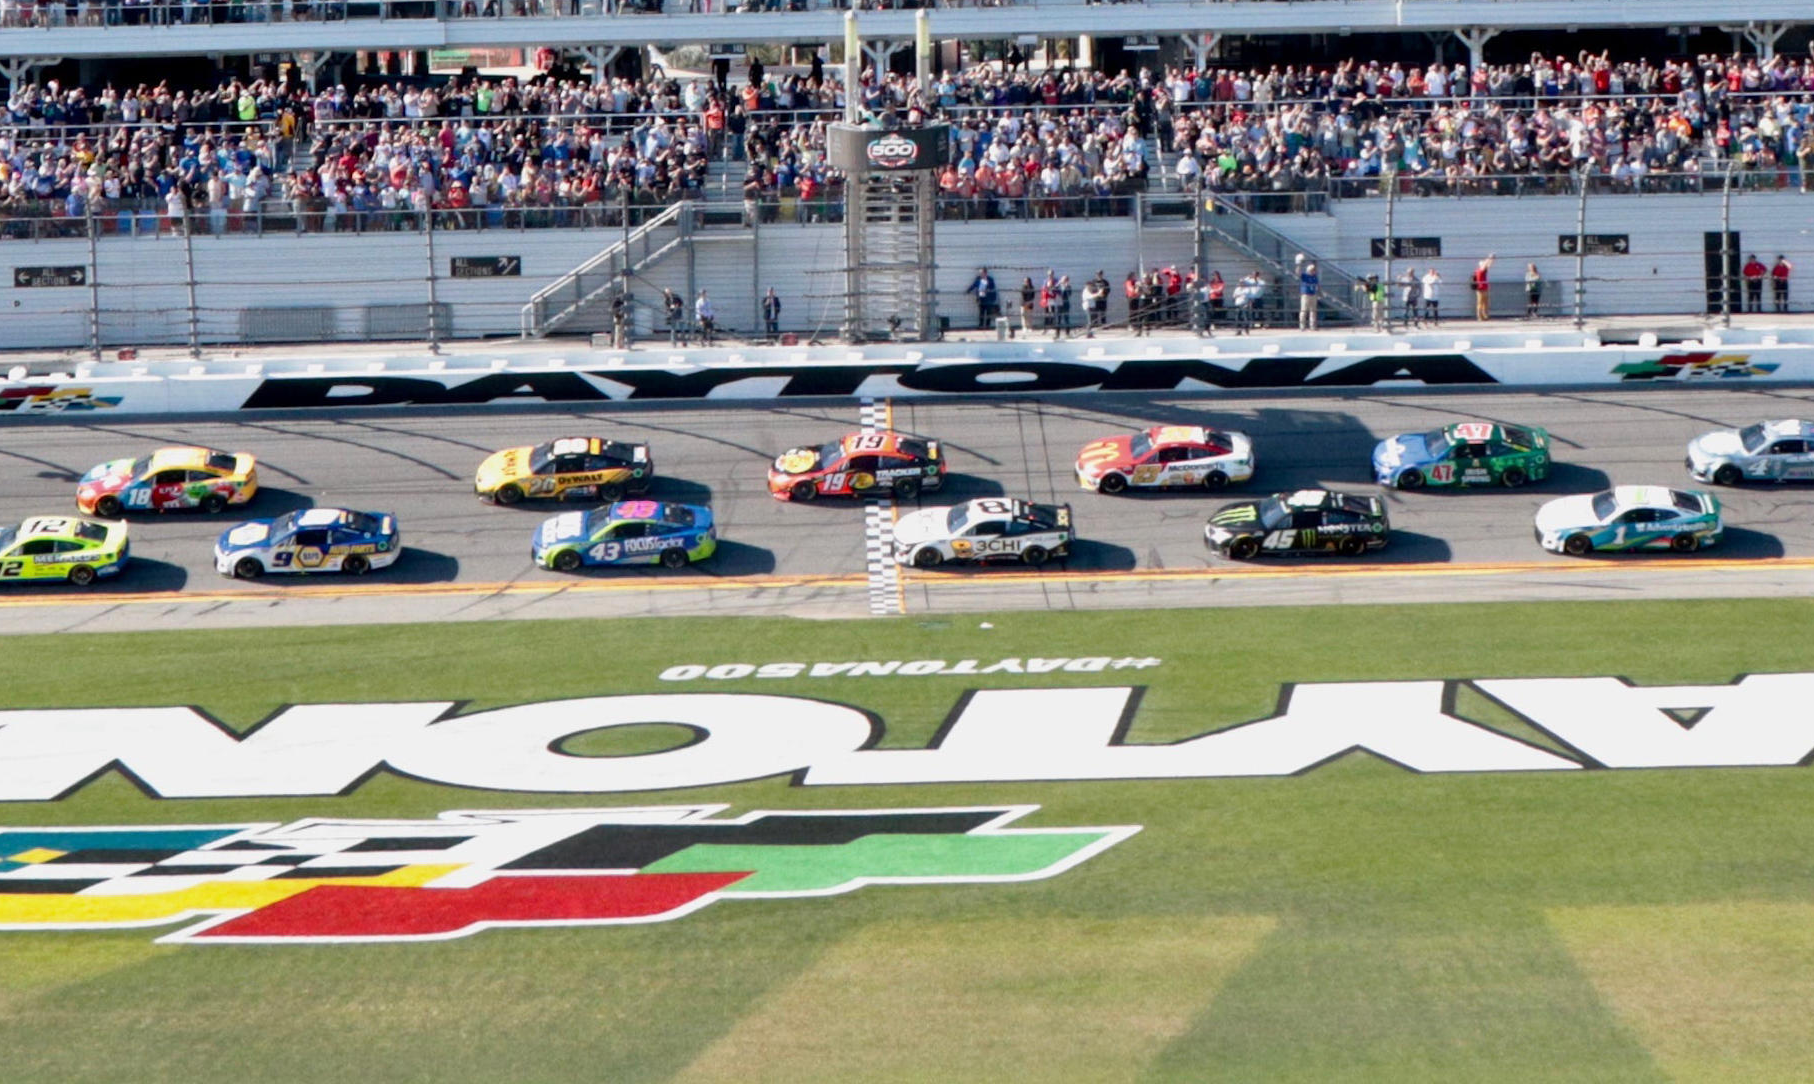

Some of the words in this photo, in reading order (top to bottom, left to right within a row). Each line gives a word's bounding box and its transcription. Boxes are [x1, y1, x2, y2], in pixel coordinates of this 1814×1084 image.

[872, 144, 912, 156] 500
[455, 258, 468, 267] ALL
[42, 268, 55, 277] ALL
[455, 267, 492, 276] SECTIONS
[32, 277, 69, 286] SECTIONS
[241, 355, 1498, 408] DAYTONA
[1455, 424, 1492, 440] 47
[852, 436, 884, 449] 19
[875, 468, 922, 478] TRACKER
[1431, 465, 1453, 482] 47
[1748, 458, 1768, 475] 4
[823, 474, 845, 491] 19
[128, 488, 152, 505] 18
[977, 501, 1011, 513] 8
[30, 520, 67, 533] 12
[1262, 529, 1299, 549] 45
[1613, 526, 1627, 545] 1
[589, 543, 621, 562] 43
[975, 541, 1022, 552] 3CHI
[272, 551, 294, 567] 9
[658, 656, 1164, 682] #DAYTONA500
